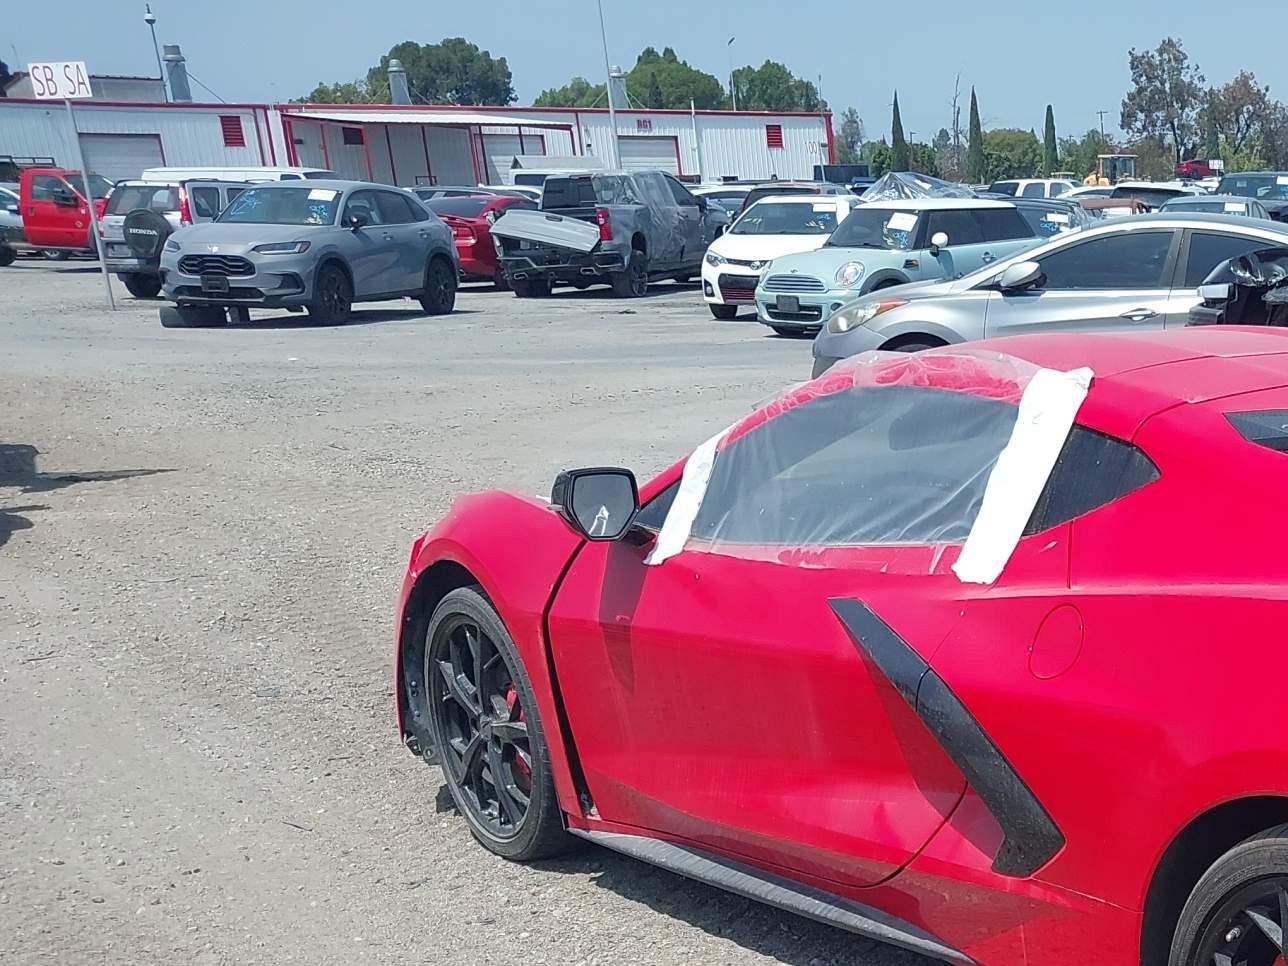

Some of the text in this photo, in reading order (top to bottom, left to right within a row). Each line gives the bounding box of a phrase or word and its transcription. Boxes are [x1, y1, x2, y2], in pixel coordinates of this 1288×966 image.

[31, 64, 90, 97] SB SA
[129, 227, 158, 236] HONDA
